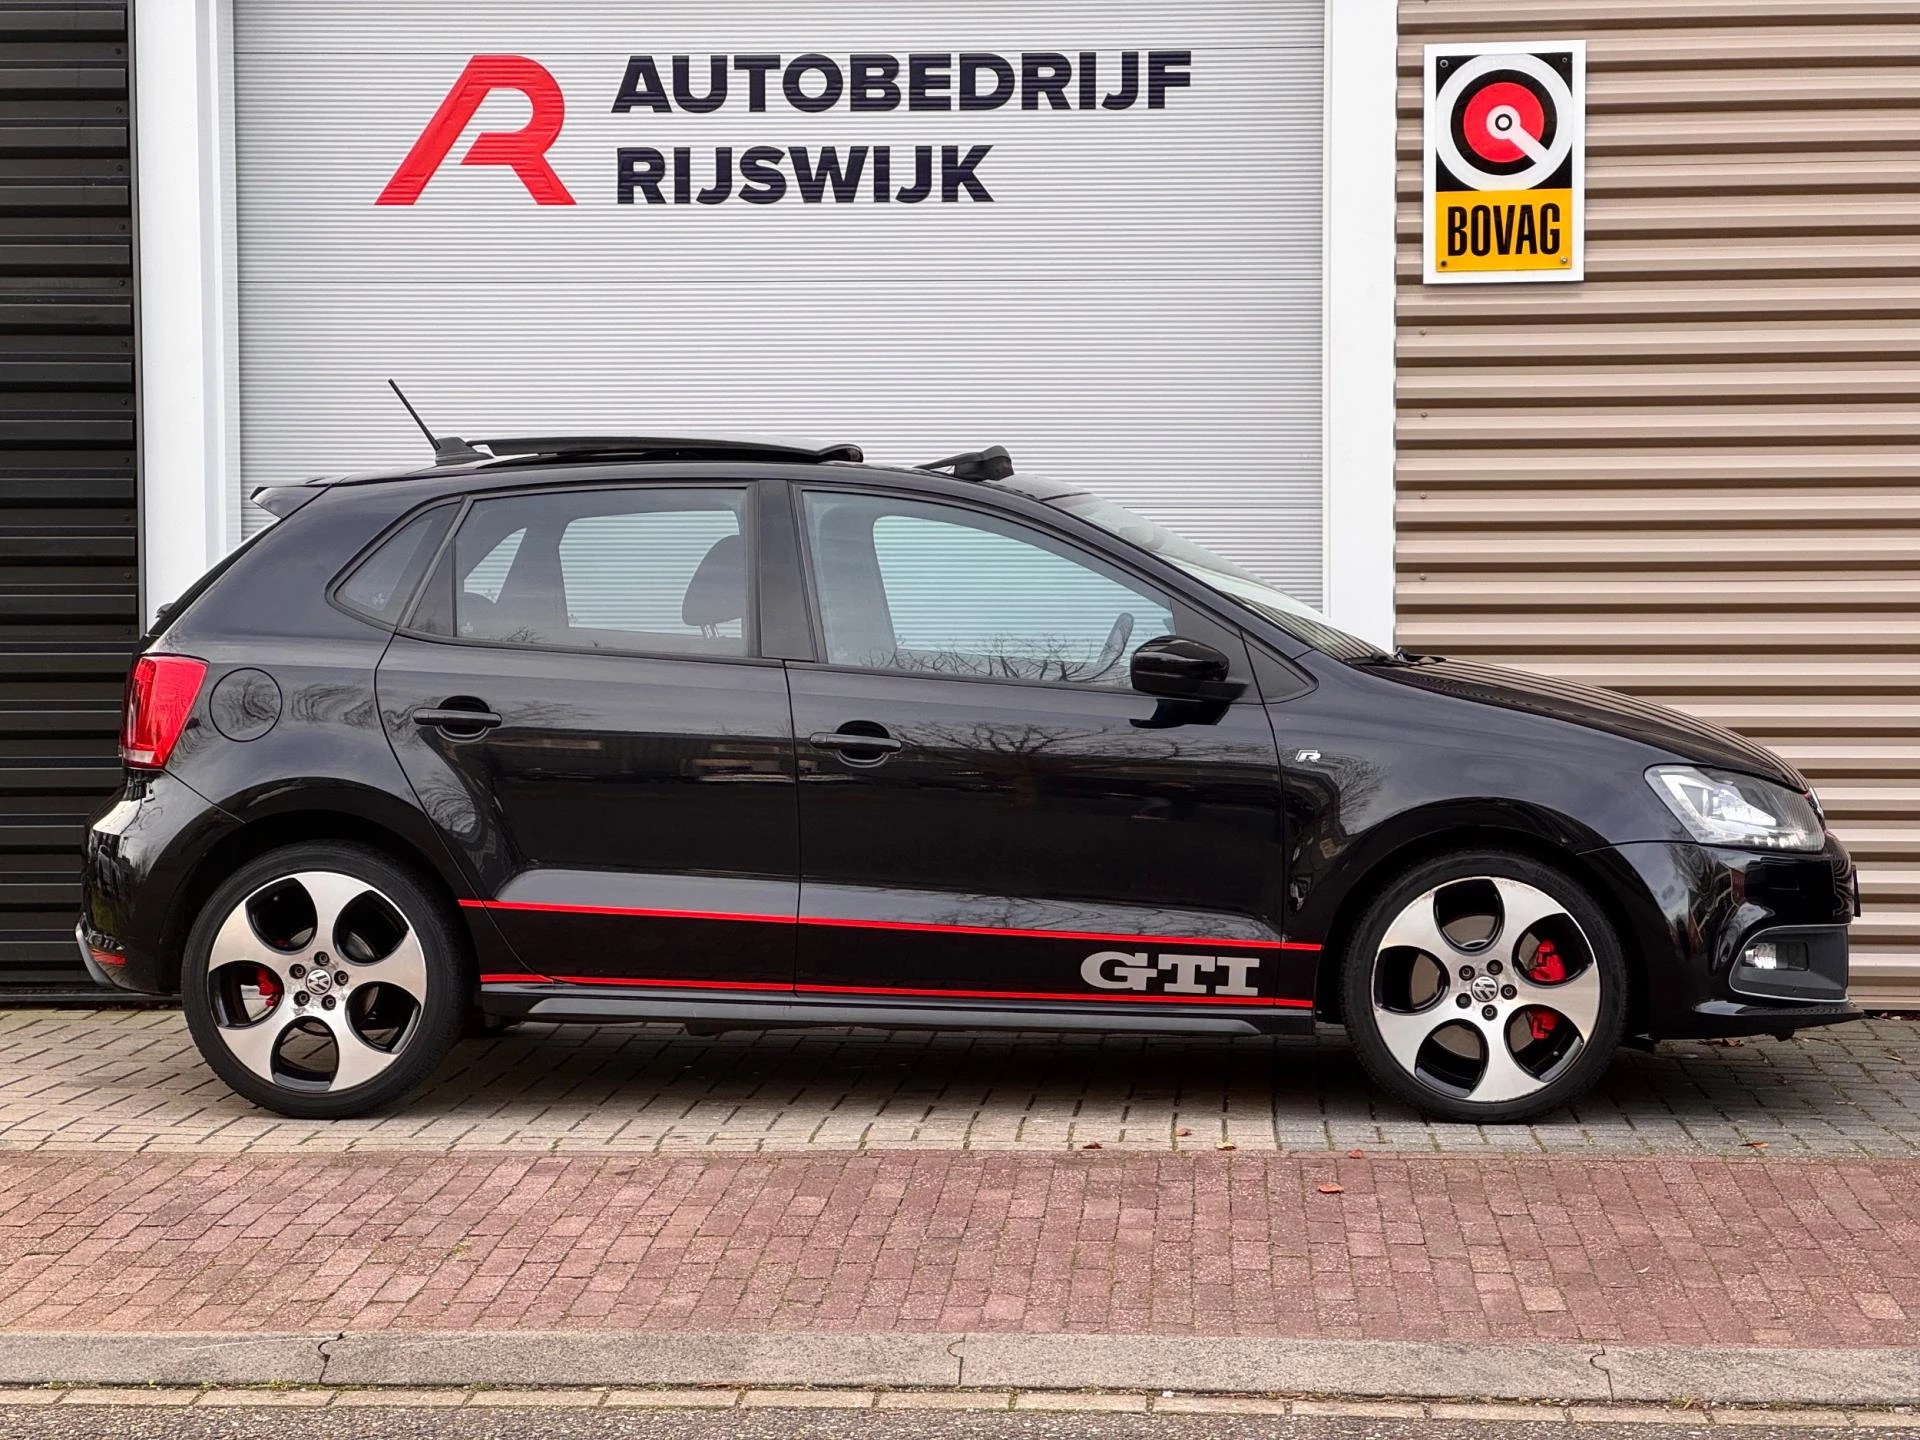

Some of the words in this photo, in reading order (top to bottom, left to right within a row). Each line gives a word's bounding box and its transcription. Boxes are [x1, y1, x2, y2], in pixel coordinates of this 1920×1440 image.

[610, 50, 1193, 114] AUTOBEDRIJF
[615, 144, 996, 205] RIJSWIJK
[1447, 202, 1561, 257] BOVAG
[1080, 951, 1261, 997] GTI
